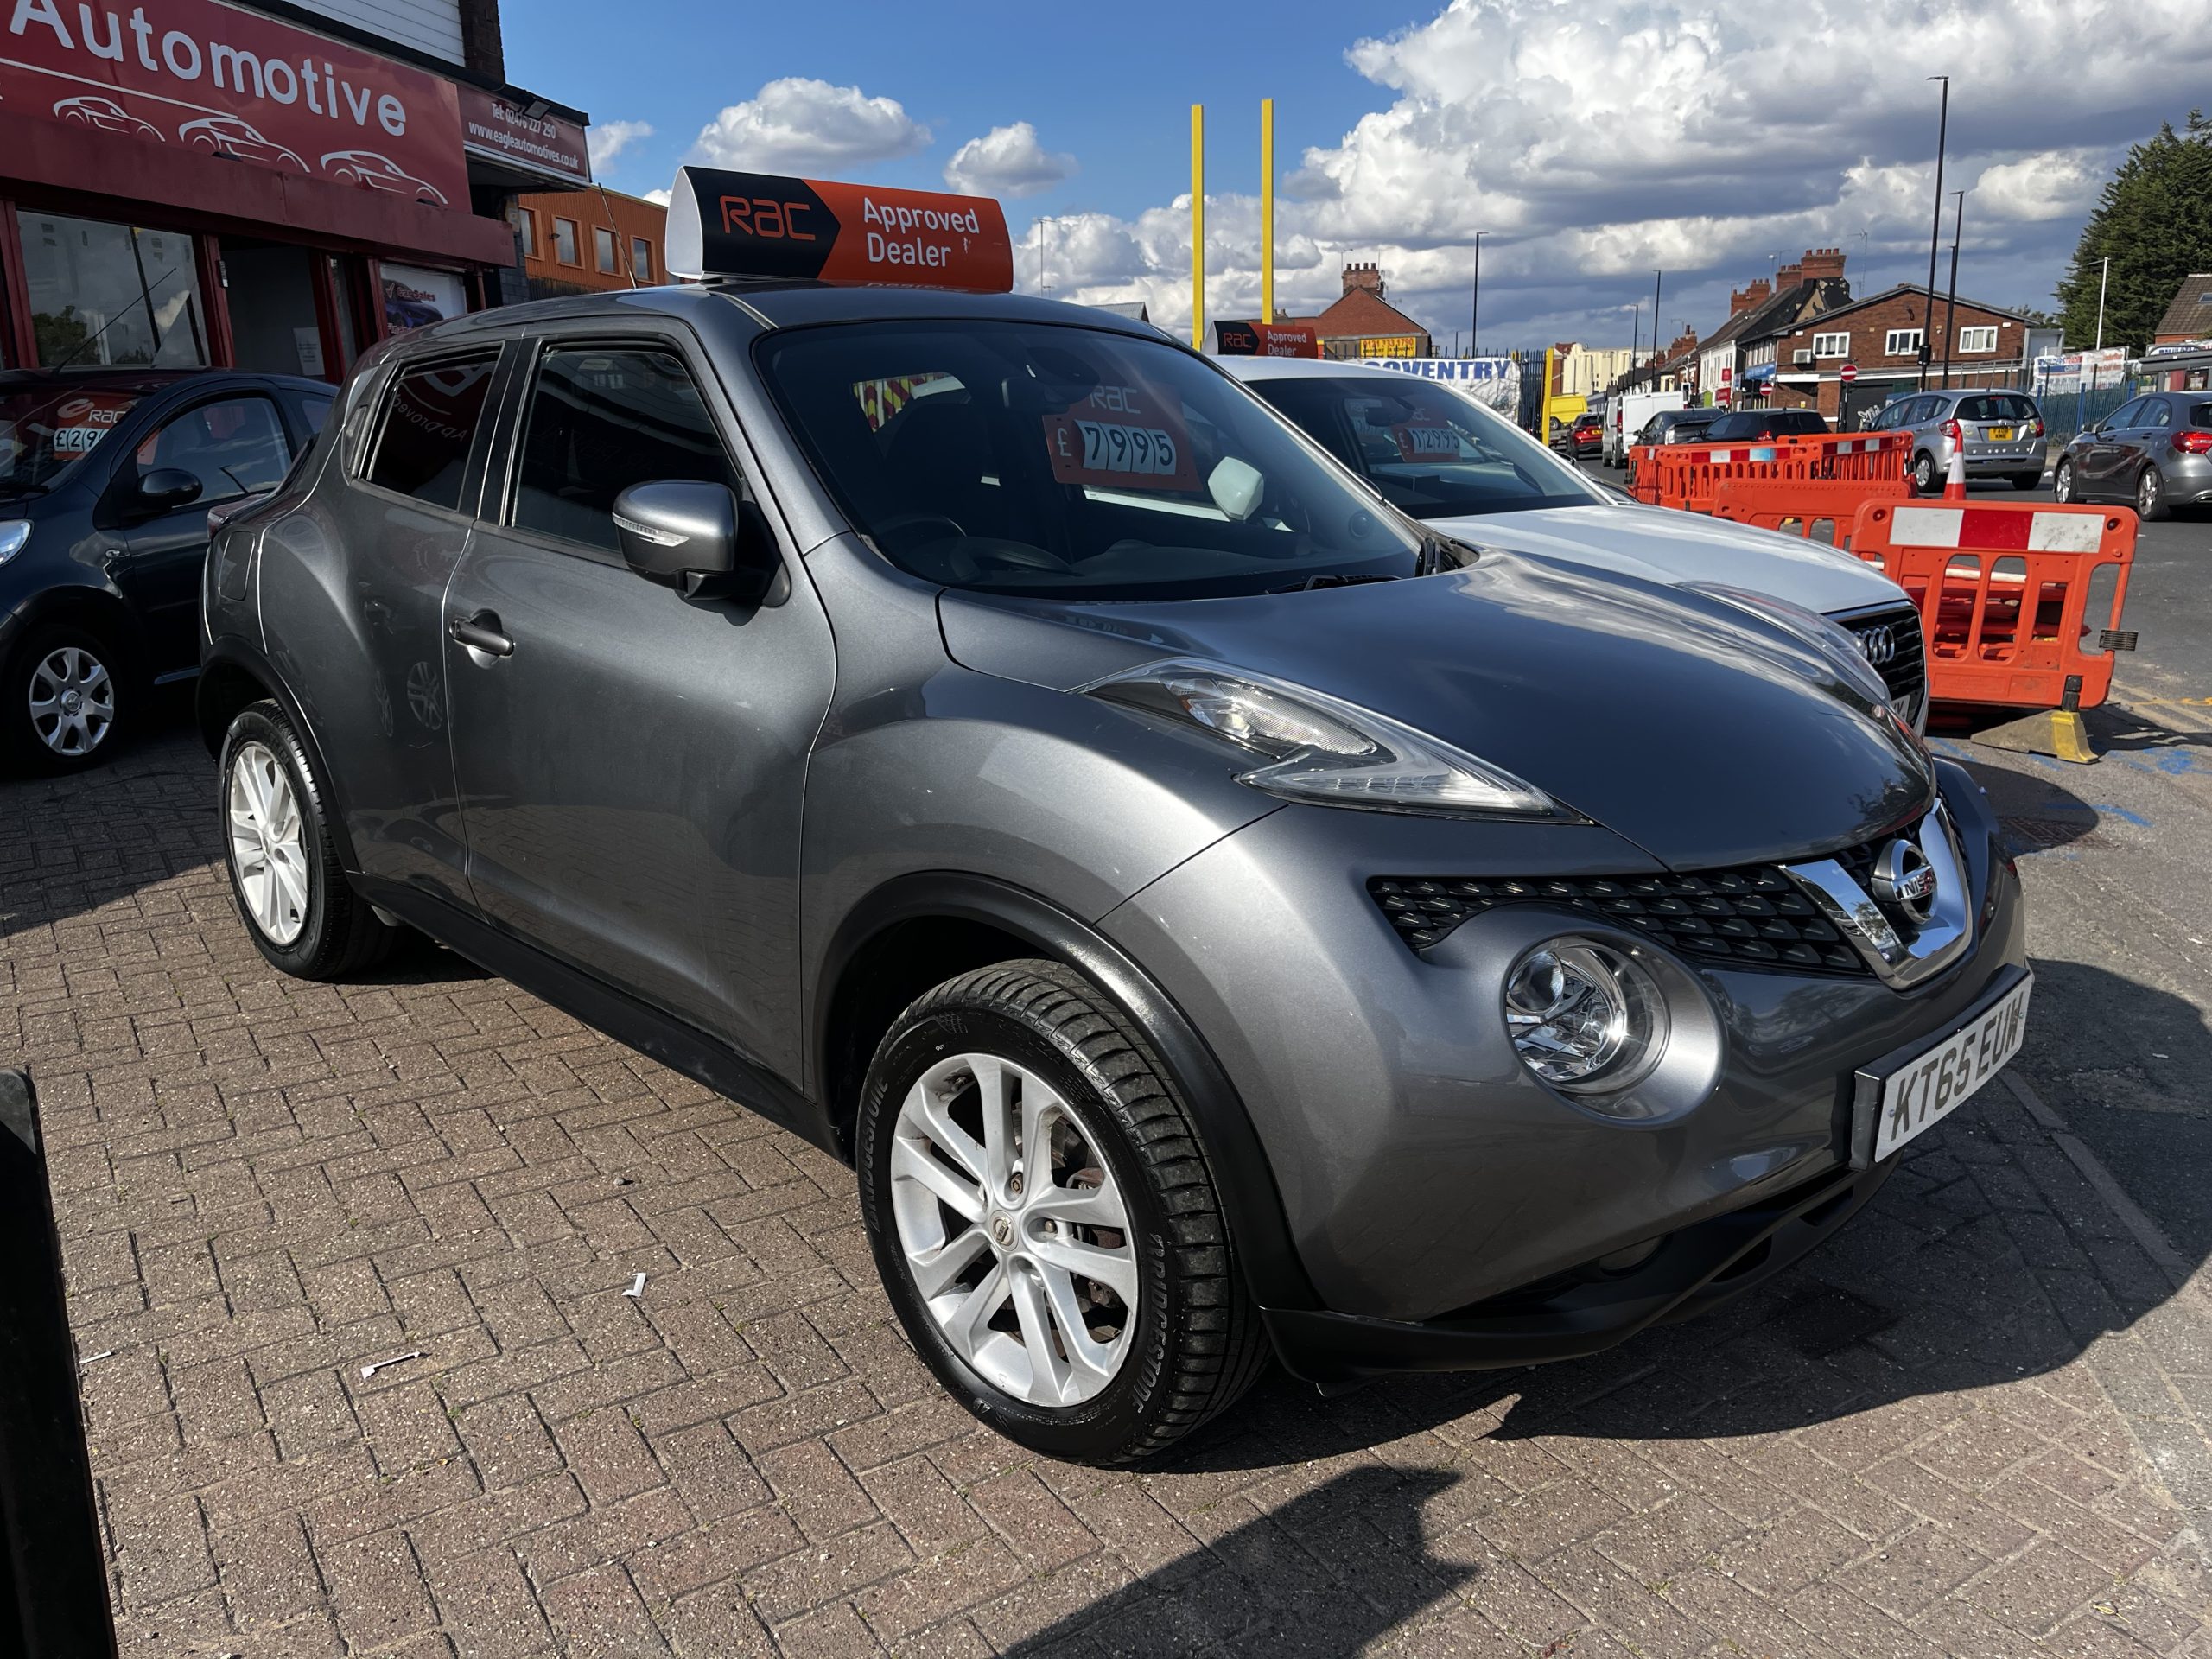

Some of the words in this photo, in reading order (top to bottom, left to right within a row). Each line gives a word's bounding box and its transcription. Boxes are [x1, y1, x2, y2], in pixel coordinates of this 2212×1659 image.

[9, 0, 407, 137] Automotive
[492, 103, 505, 120] Tel:
[543, 122, 556, 139] 290
[468, 122, 579, 169] www.eagleautomotives.co.uk
[864, 197, 980, 234] Approved
[867, 232, 951, 267] Dealer
[1267, 330, 1306, 343] Approved
[1268, 344, 1297, 356] Dealer
[1364, 360, 1511, 380] OVENTRY
[55, 429, 99, 448] £29
[1057, 428, 1072, 457] £
[1084, 426, 1173, 467] 7995
[1890, 1032, 1977, 1142] KT65
